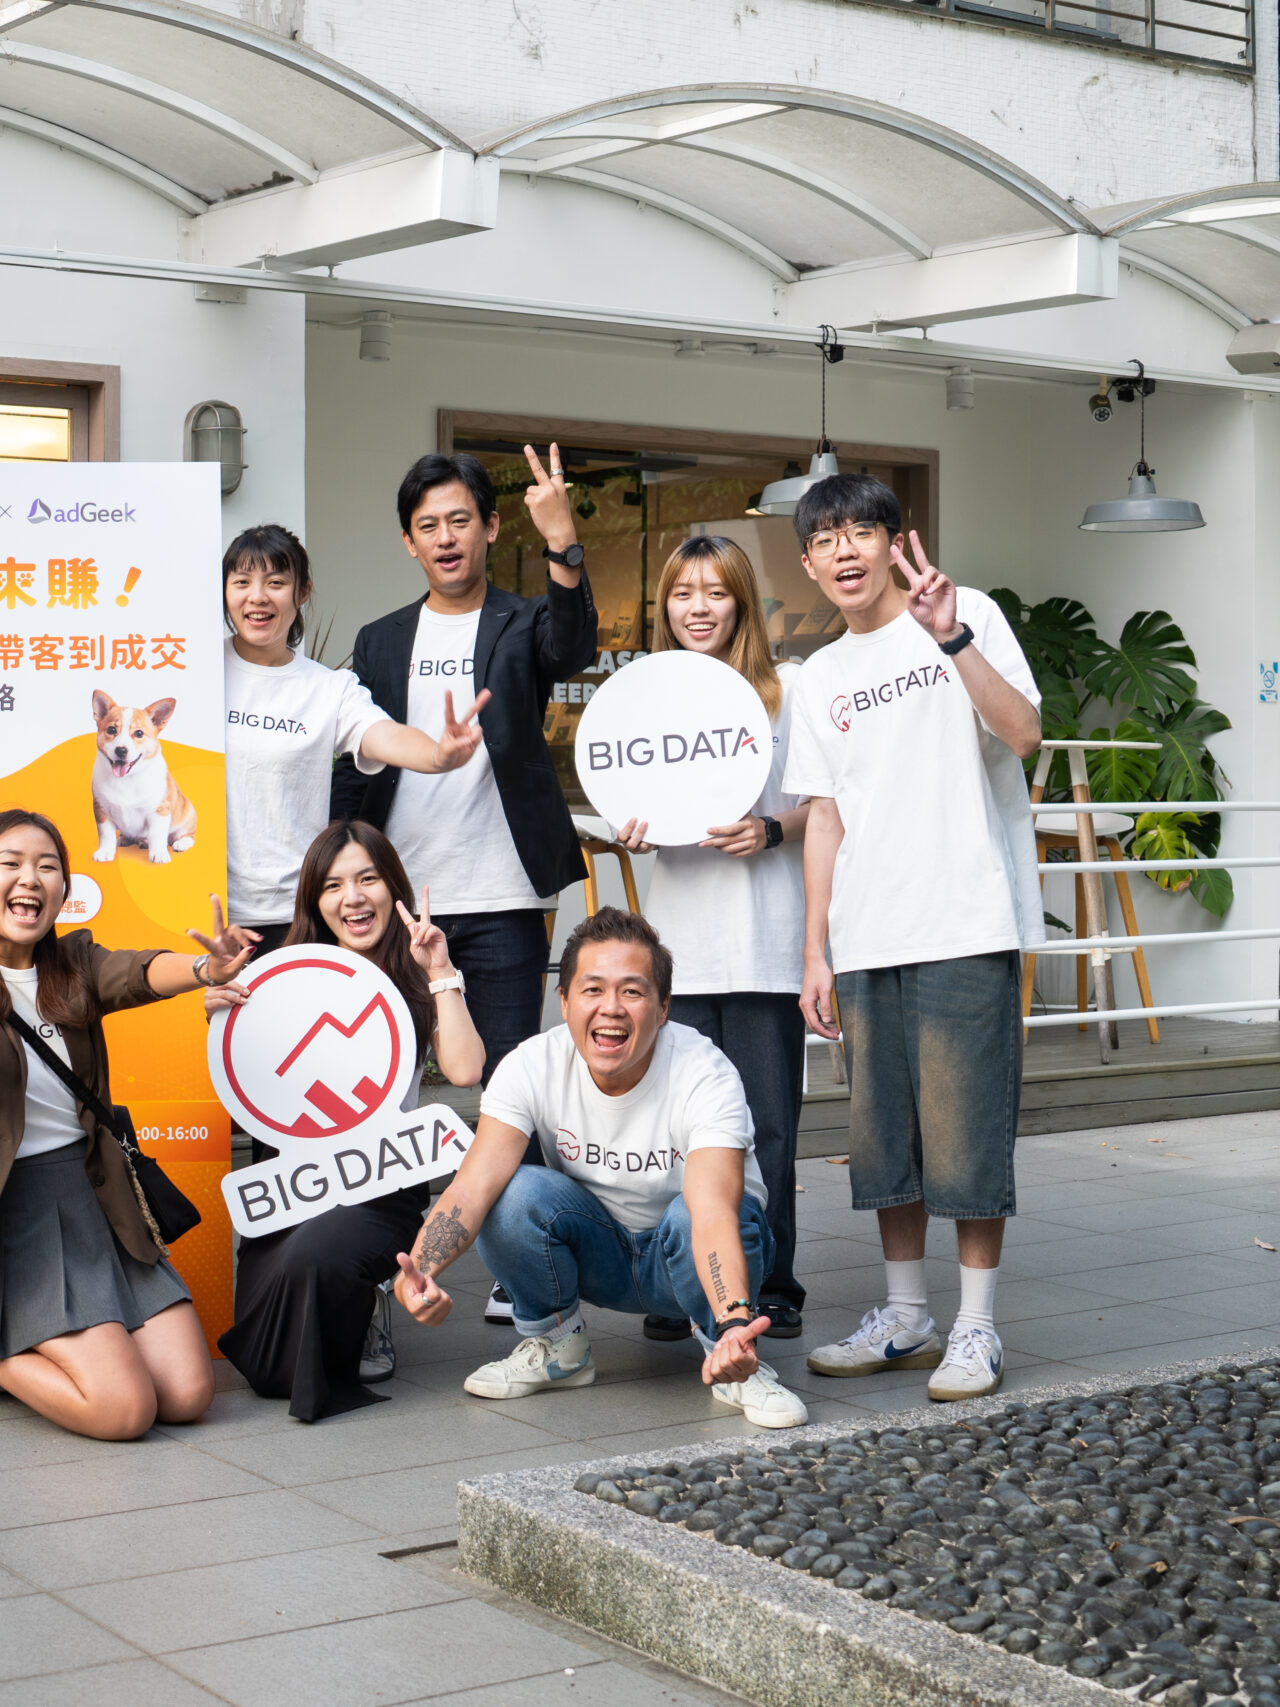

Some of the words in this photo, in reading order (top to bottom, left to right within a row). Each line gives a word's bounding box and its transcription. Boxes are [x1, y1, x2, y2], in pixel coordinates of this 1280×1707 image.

[53, 502, 136, 523] adGeek
[419, 659, 457, 676] BIG
[853, 689, 894, 712] BIG
[228, 710, 260, 728] BIG
[262, 716, 307, 735] DATA
[588, 737, 655, 771] BIG
[662, 726, 759, 764] DATA
[585, 1143, 621, 1171] BIG
[237, 1162, 330, 1222] BIG
[333, 1119, 466, 1191] DATA
